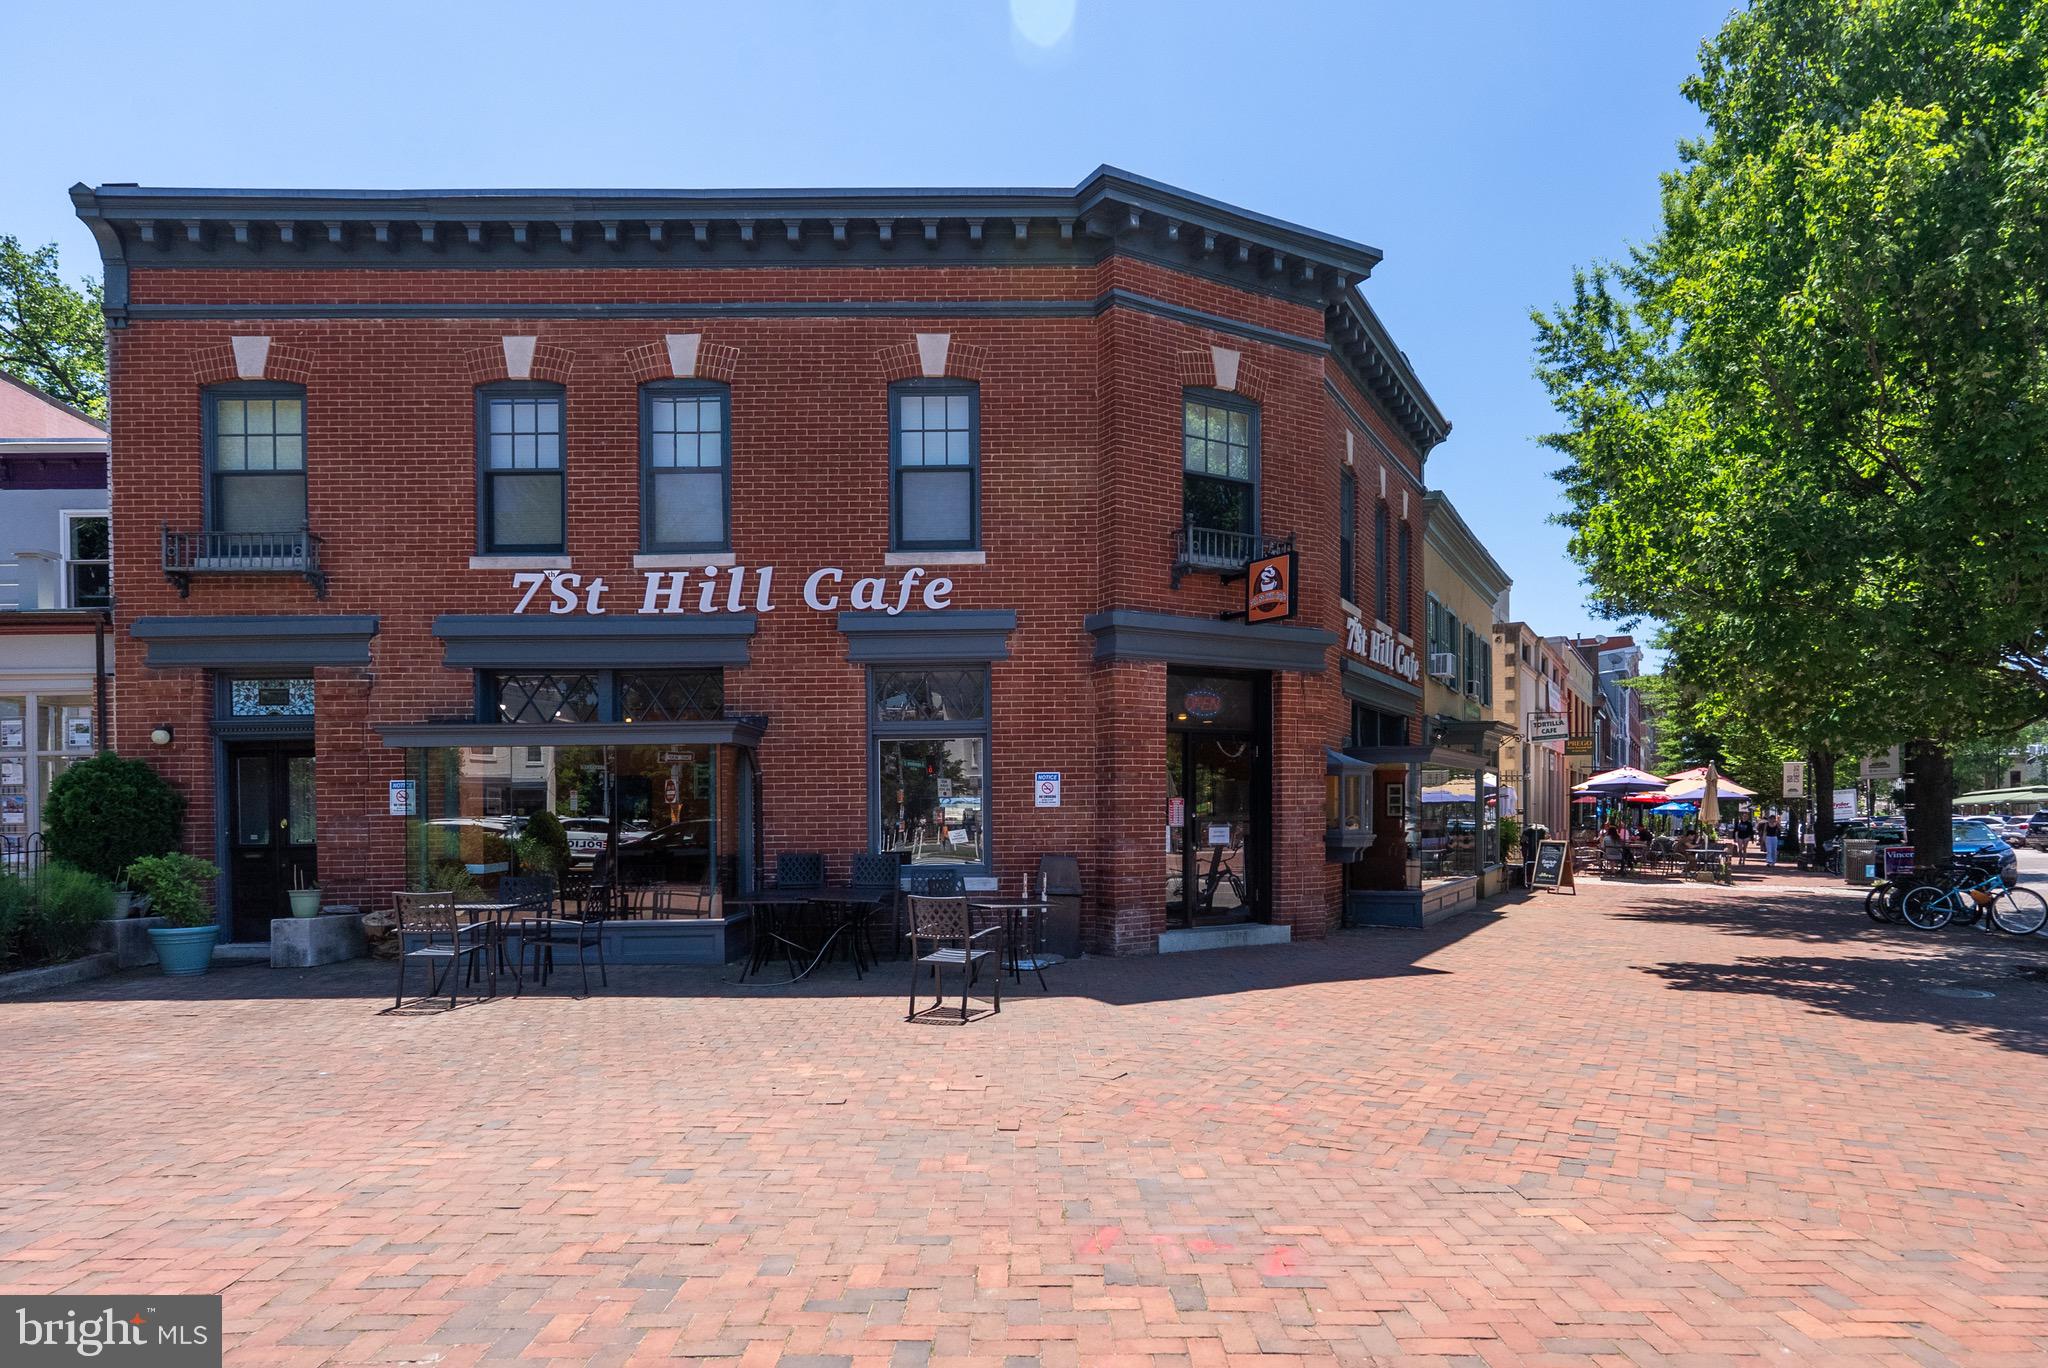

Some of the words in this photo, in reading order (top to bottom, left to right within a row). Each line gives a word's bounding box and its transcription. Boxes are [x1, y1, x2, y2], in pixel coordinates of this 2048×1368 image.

[637, 565, 775, 614] Hill
[803, 567, 953, 615] Cafe
[1369, 630, 1394, 670] Hill
[1395, 644, 1420, 682] Cafe
[1533, 719, 1564, 728] TORTILLA
